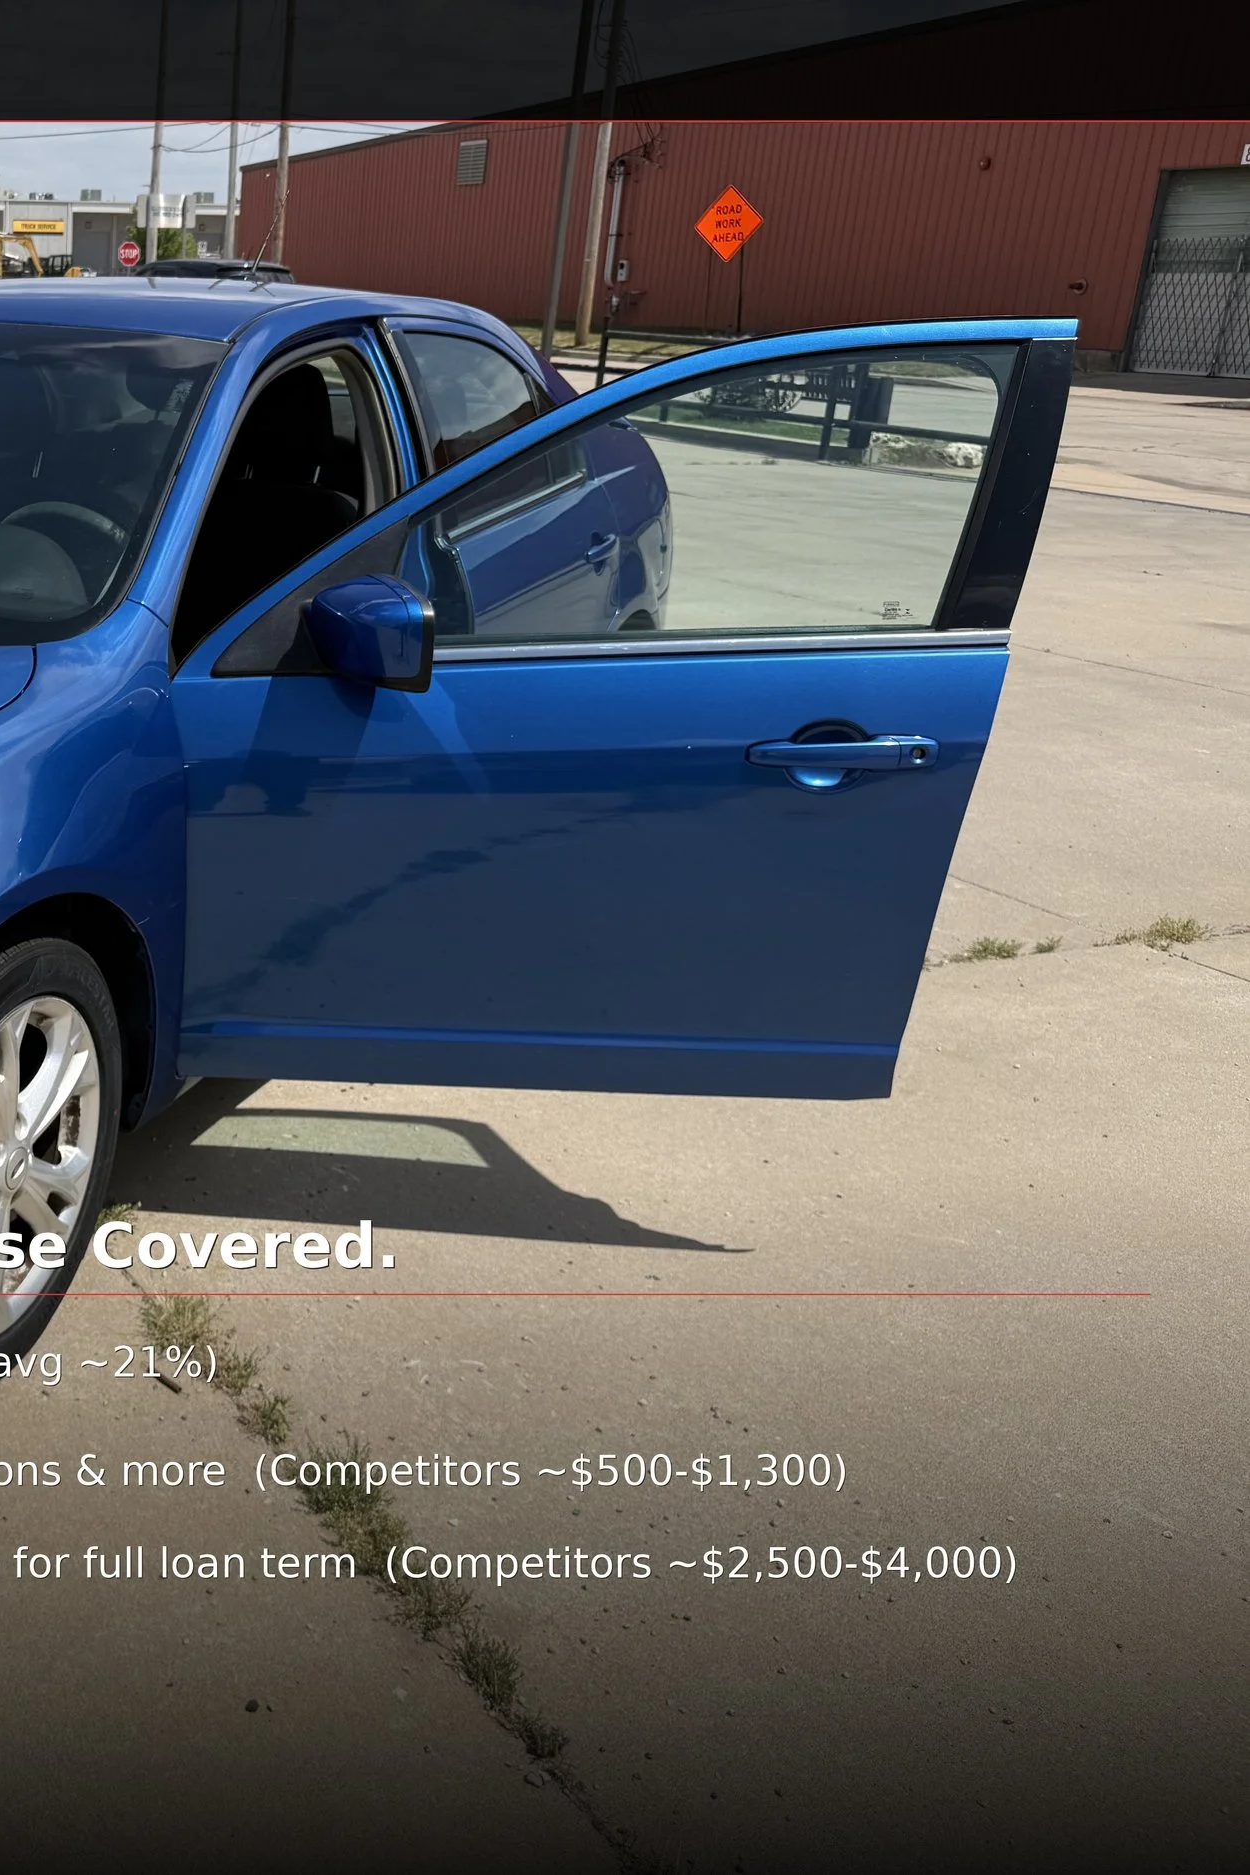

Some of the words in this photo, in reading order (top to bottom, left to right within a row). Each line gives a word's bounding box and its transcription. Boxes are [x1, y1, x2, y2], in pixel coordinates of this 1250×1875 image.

[715, 204, 743, 215] ROAD
[715, 218, 742, 229] WORK
[712, 231, 745, 243] AHEAD
[119, 248, 139, 259] STOP
